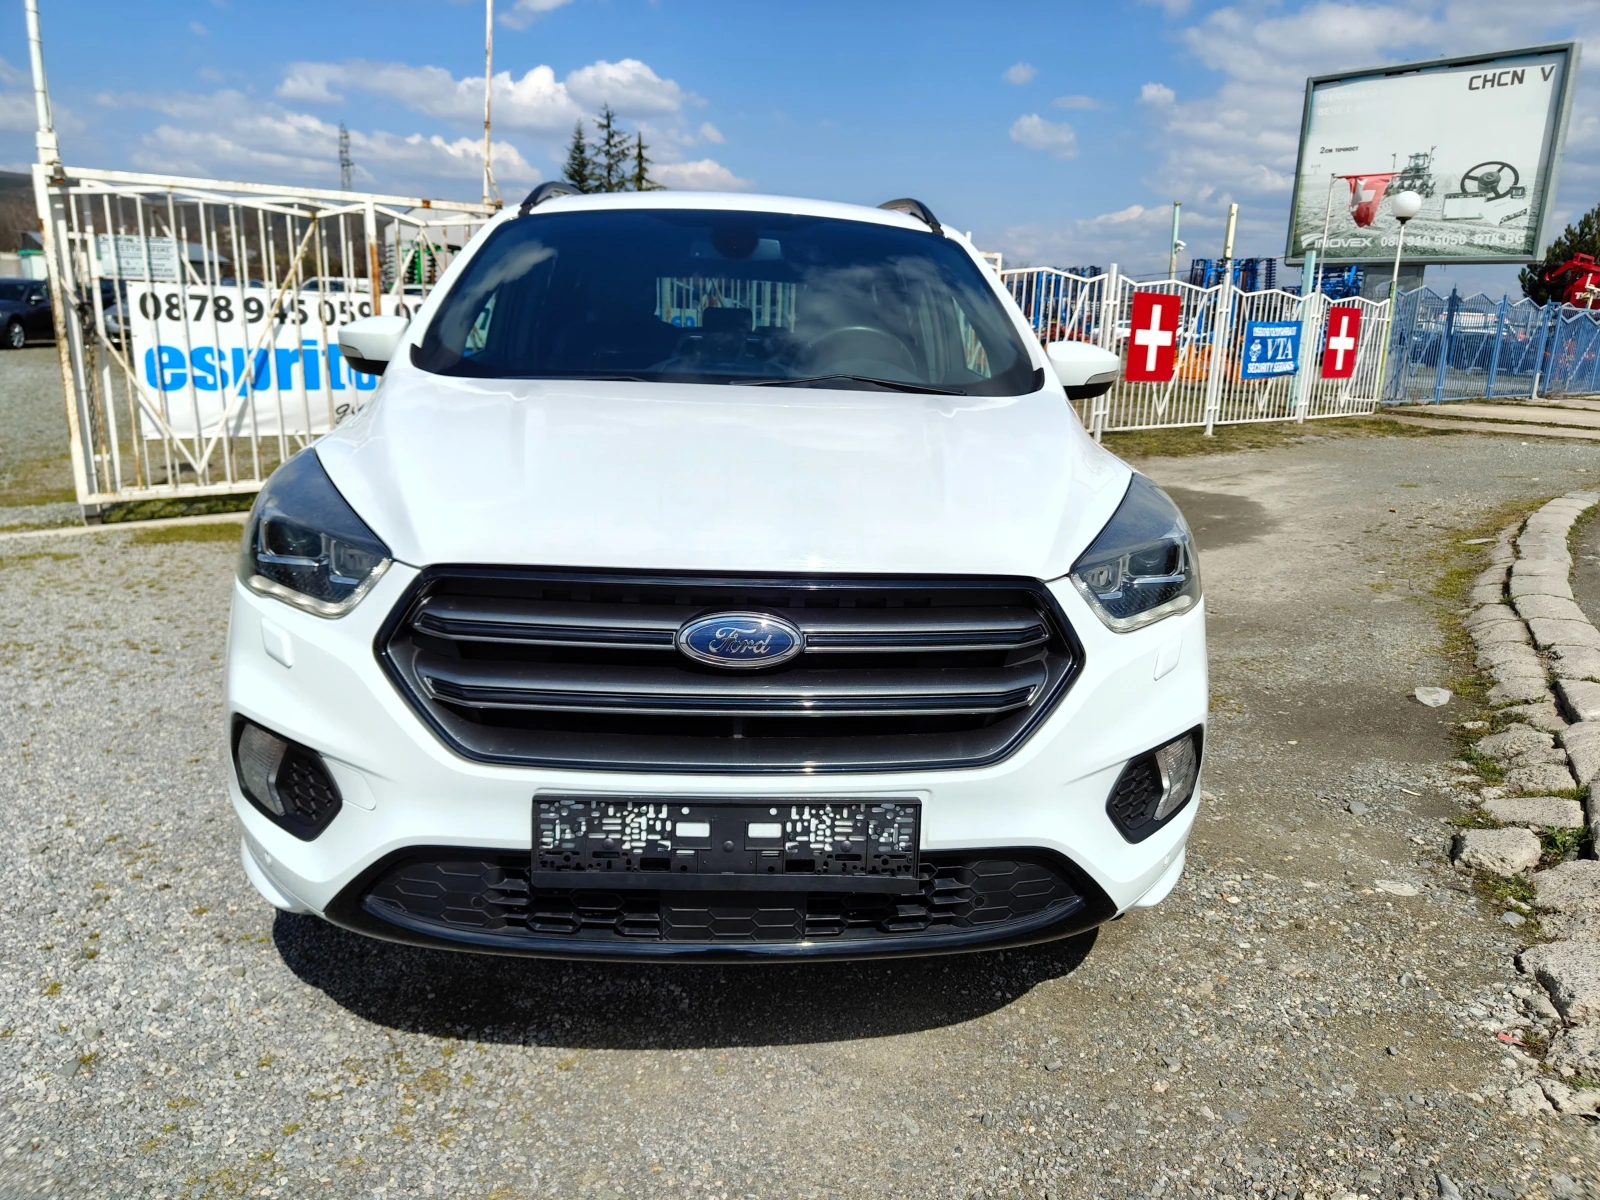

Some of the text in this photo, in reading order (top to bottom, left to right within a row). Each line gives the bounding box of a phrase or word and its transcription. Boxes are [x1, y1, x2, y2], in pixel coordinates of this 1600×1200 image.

[1468, 69, 1525, 91] CHCN
[1314, 237, 1372, 249] INOVEX
[1434, 234, 1467, 246] 5050
[139, 292, 234, 322] 0878
[243, 297, 309, 326] 945
[1266, 337, 1293, 360] VTA
[709, 627, 772, 654] Ford
